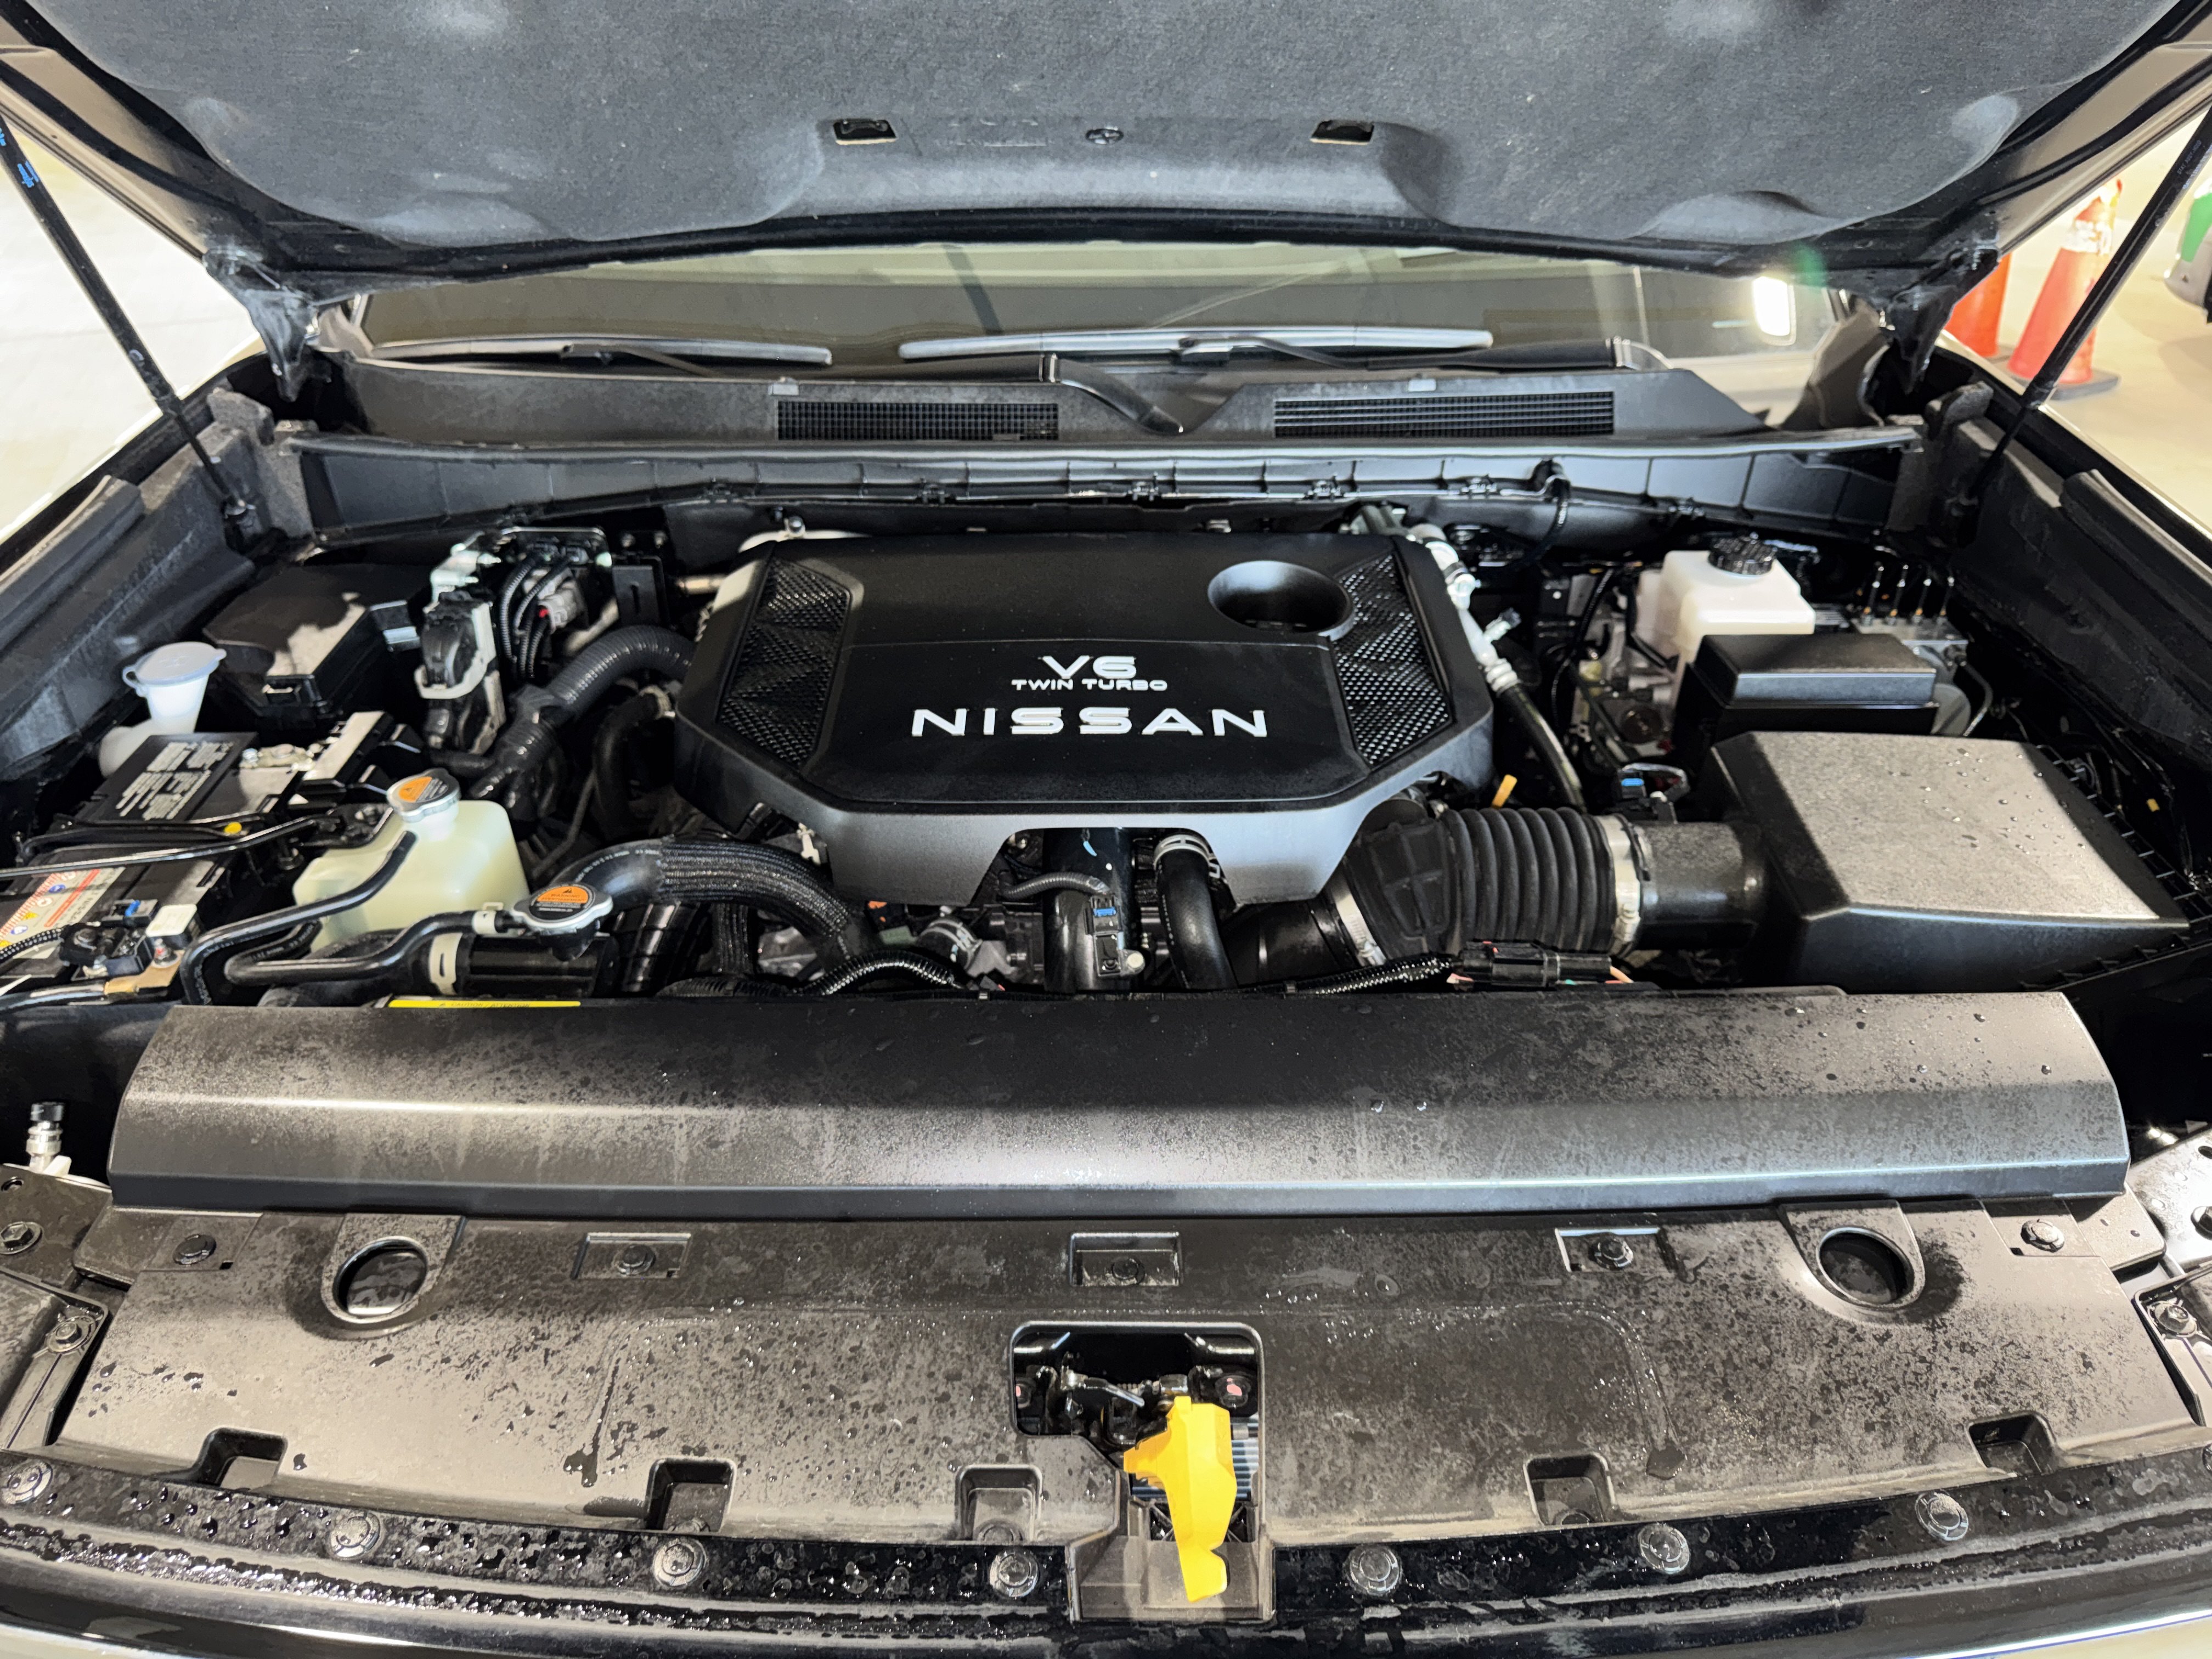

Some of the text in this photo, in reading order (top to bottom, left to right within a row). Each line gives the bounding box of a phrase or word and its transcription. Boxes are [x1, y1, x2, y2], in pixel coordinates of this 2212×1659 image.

[1042, 655, 1137, 679] V6
[1011, 679, 1167, 691] TWIN TURBO
[911, 707, 1268, 737] NISSAN
